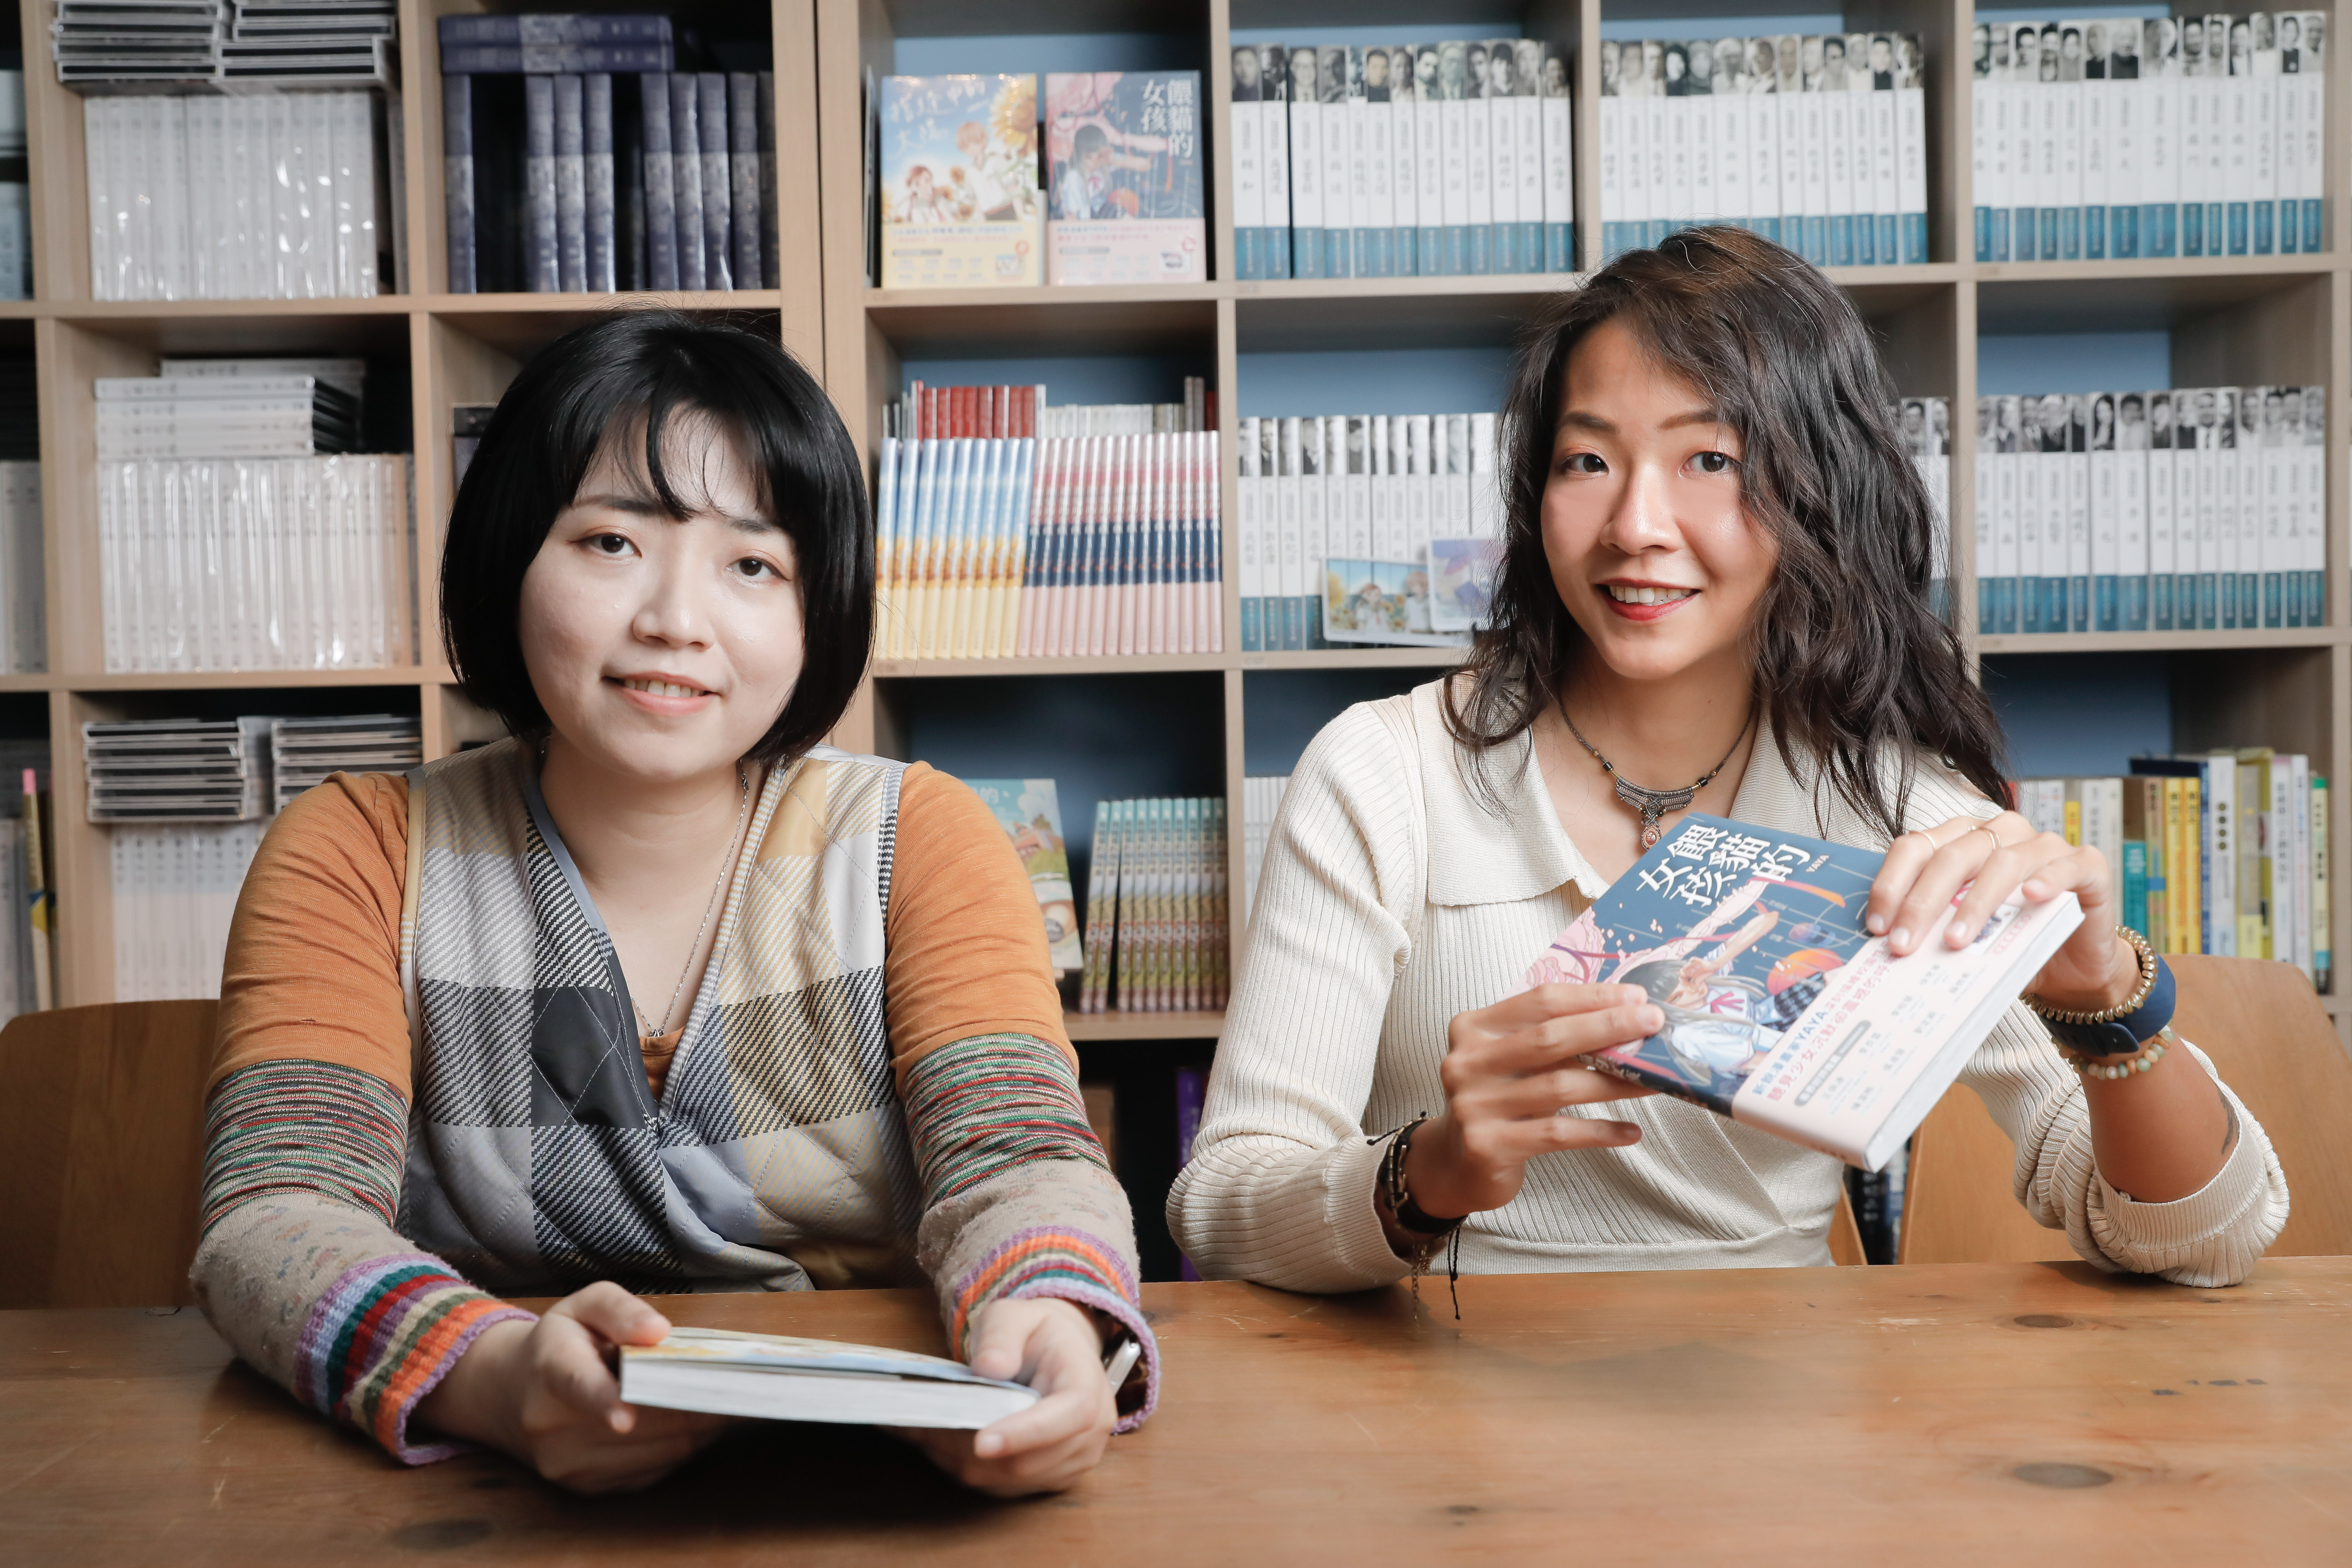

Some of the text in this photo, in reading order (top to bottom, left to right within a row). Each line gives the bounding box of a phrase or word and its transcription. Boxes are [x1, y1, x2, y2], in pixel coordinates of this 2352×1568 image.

[1141, 79, 1166, 133] 女孩
[1168, 78, 1193, 158] 餵貓的
[1666, 824, 1811, 883] 餵貓的
[1806, 855, 1830, 873] YAYA
[1636, 857, 1738, 908] 女孩
